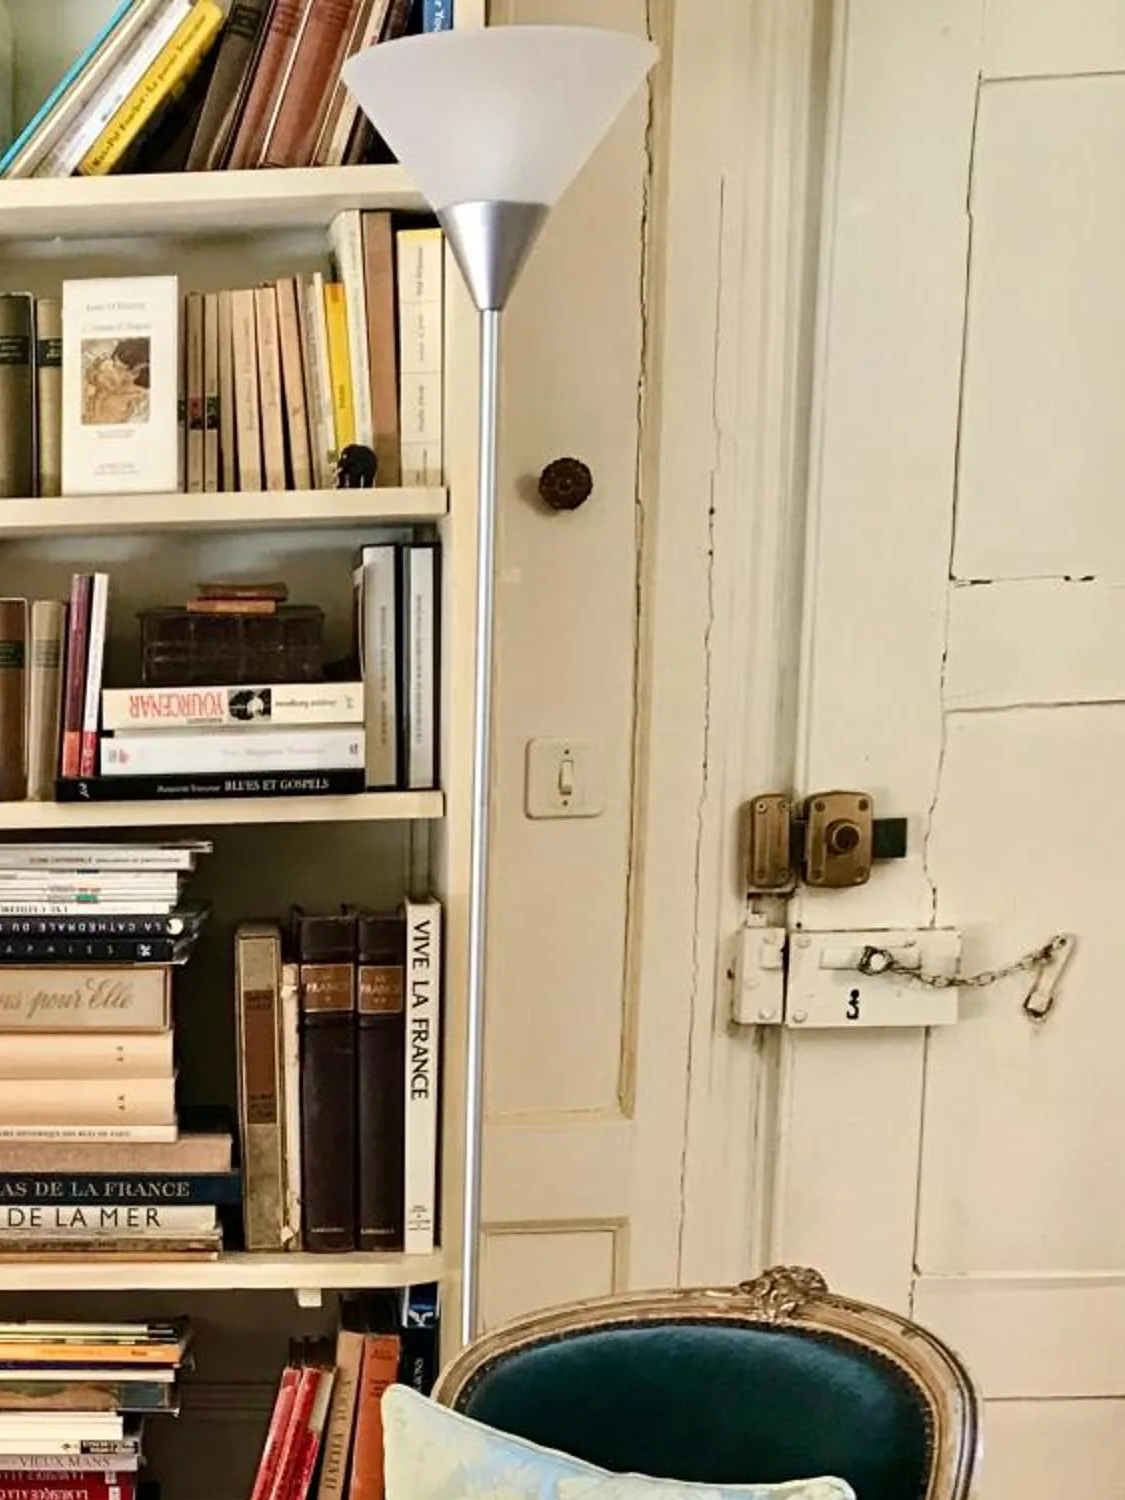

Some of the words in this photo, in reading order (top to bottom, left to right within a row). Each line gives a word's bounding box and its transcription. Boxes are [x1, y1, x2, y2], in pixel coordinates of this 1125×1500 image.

[128, 691, 225, 719] YOURCENAR
[224, 780, 260, 792] BLUES
[261, 779, 277, 791] ET
[280, 778, 330, 790] GOSPELS
[412, 919, 431, 969] VIVE
[26, 988, 84, 1019] pour
[84, 978, 135, 1010] Elle
[411, 980, 430, 1008] LA
[410, 1018, 429, 1101] FRANCE
[34, 1181, 63, 1198] DE
[71, 1181, 100, 1198] LA
[103, 1181, 191, 1198] FRANCE
[7, 1207, 42, 1227] DE
[55, 1207, 85, 1227] LA
[99, 1207, 161, 1227] MER
[67, 1456, 111, 1467] MANS
